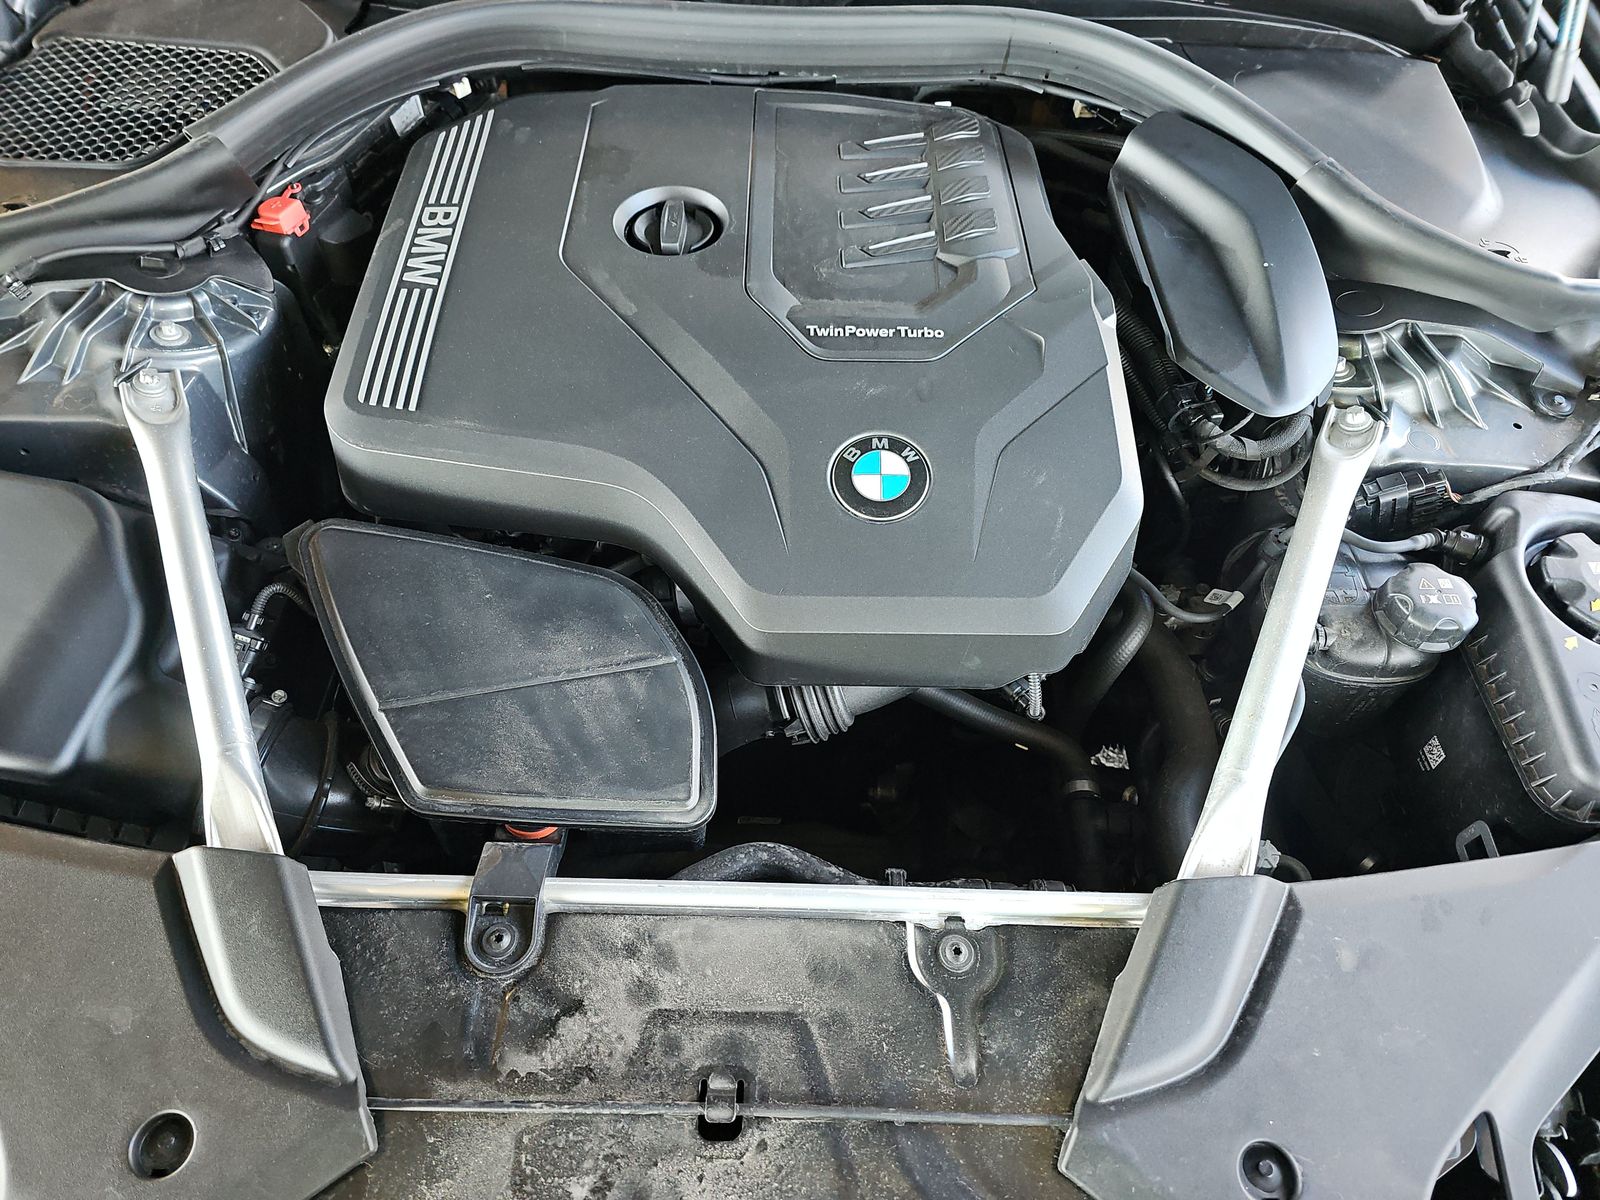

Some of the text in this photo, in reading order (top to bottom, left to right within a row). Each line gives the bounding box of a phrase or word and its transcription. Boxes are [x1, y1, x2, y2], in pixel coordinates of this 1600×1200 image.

[402, 206, 459, 285] BMW
[897, 326, 945, 338] Turbo
[843, 437, 920, 463] BMW
